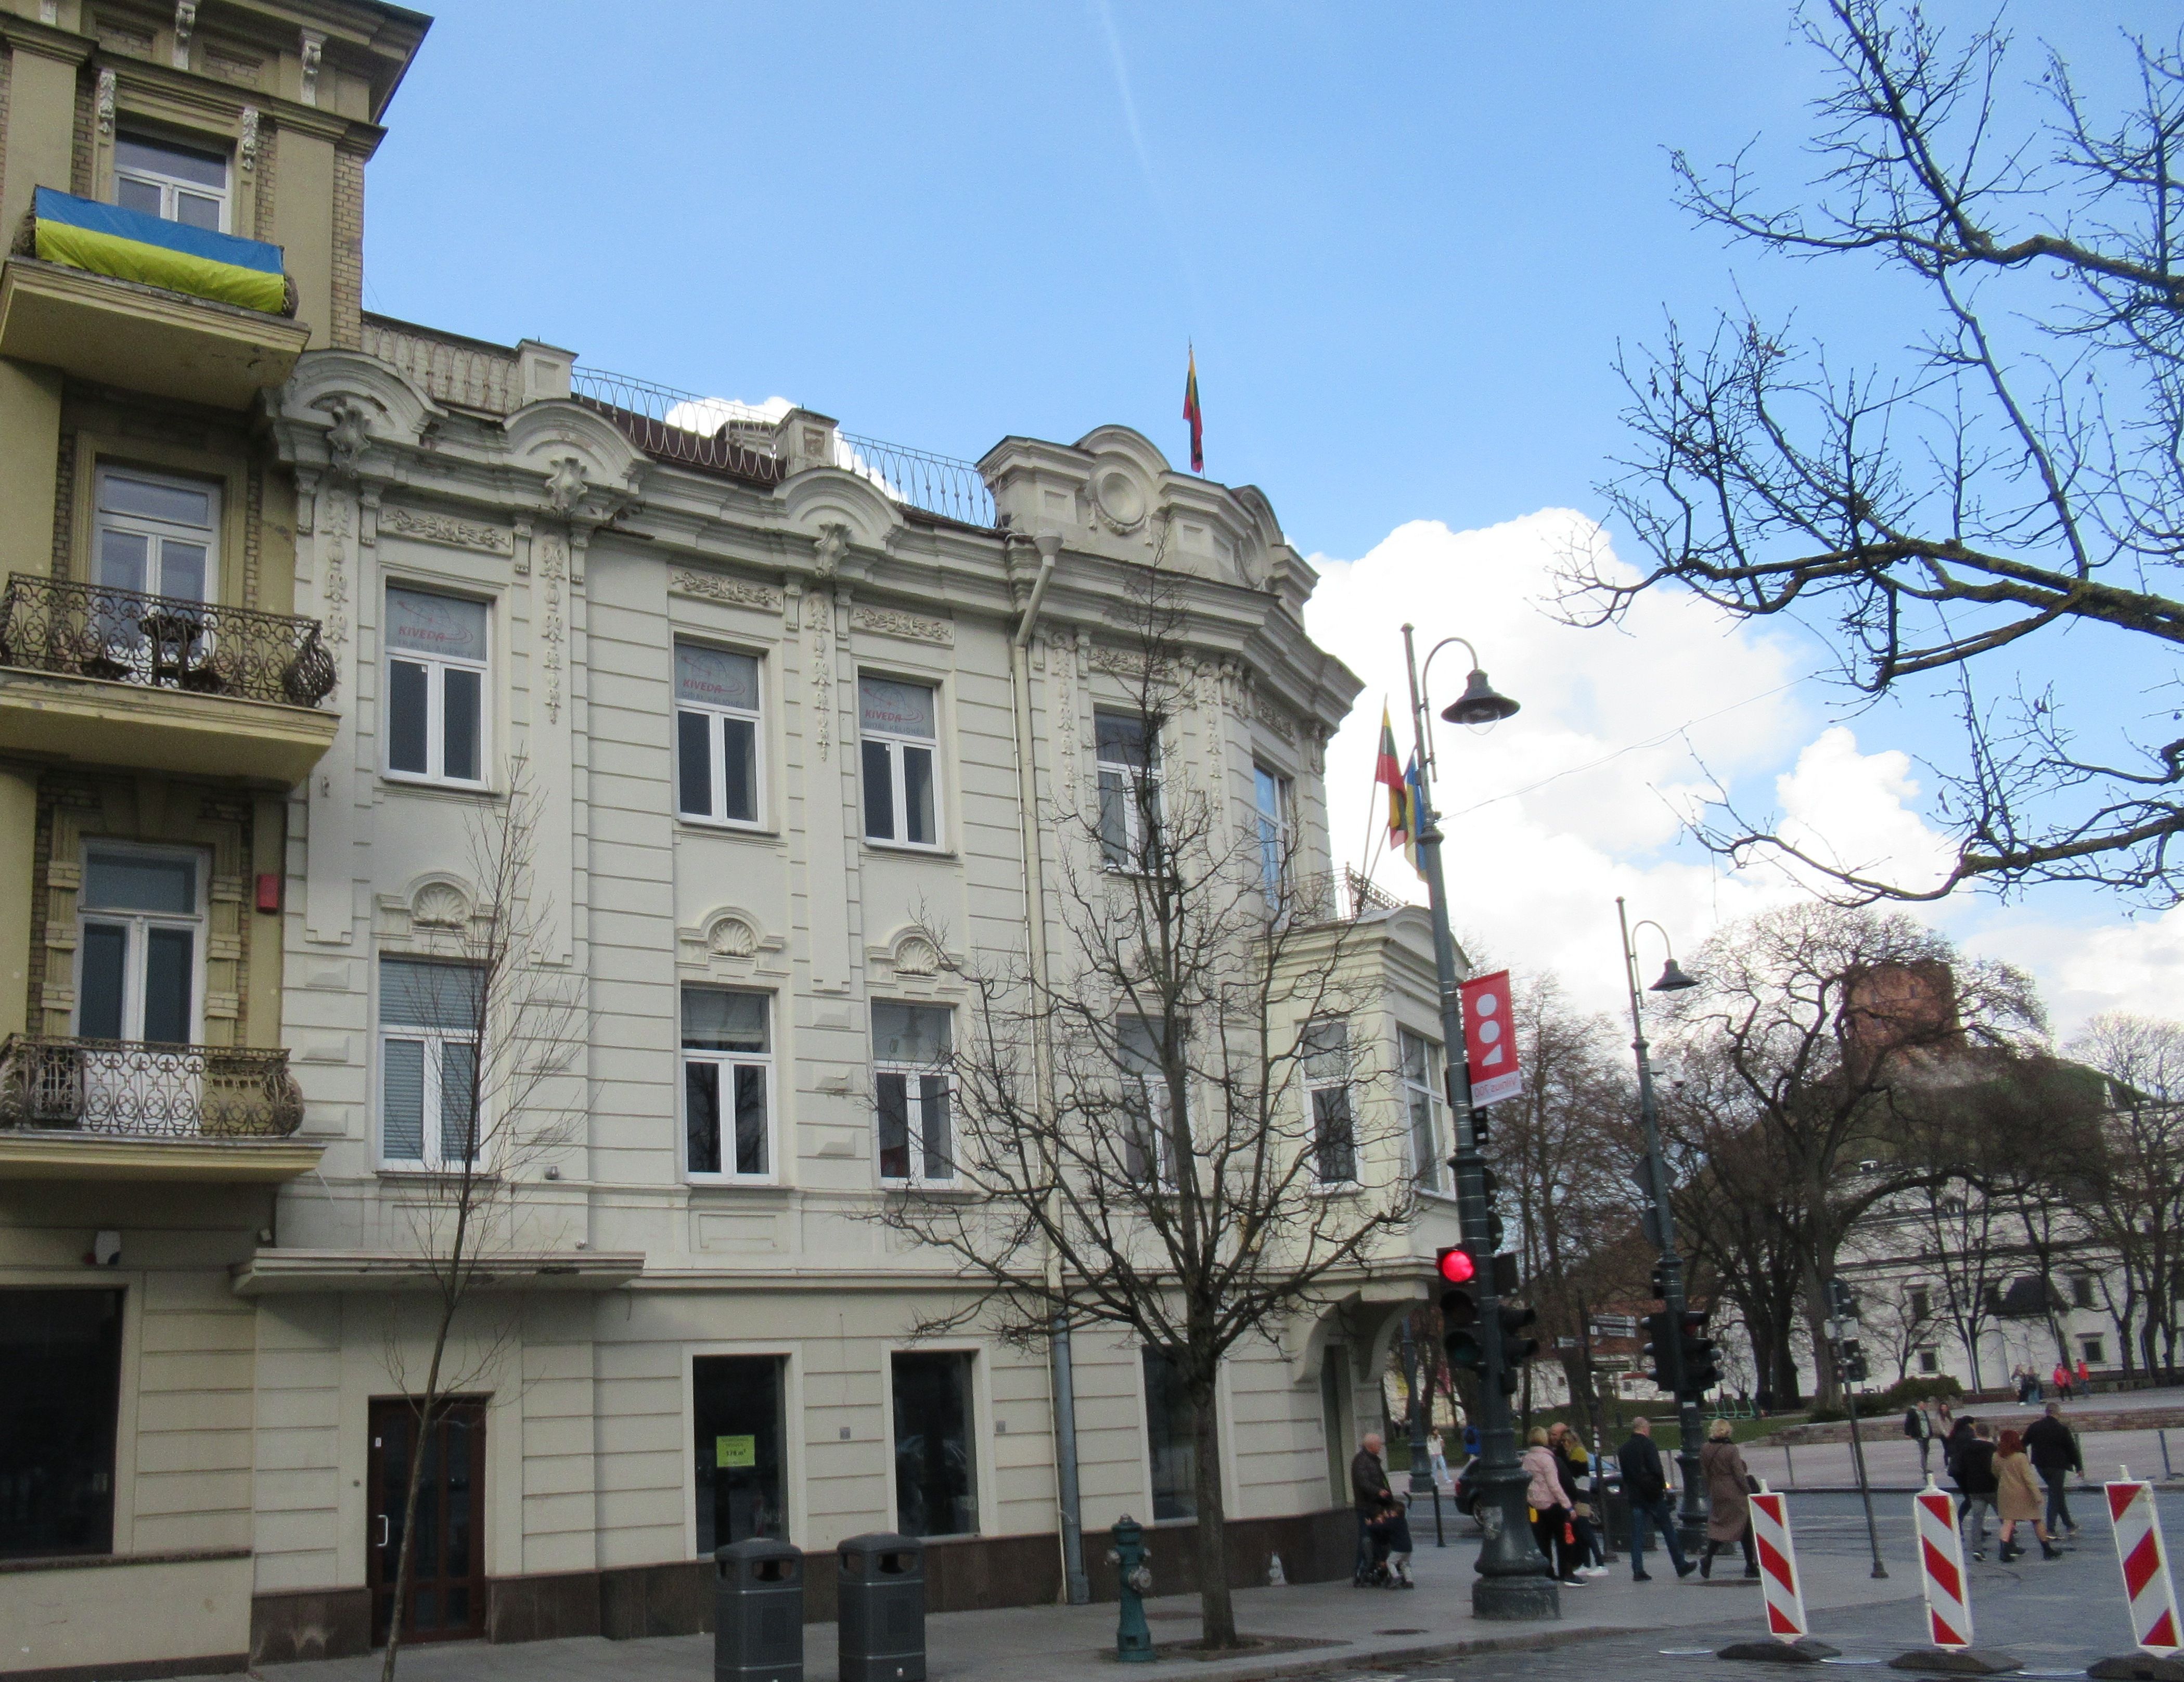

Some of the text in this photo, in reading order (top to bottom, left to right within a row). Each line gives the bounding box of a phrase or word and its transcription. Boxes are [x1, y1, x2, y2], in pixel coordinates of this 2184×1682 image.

[399, 626, 445, 641] KIVEDA
[683, 679, 722, 693] KIVEDA
[865, 709, 902, 723] KIVEDA
